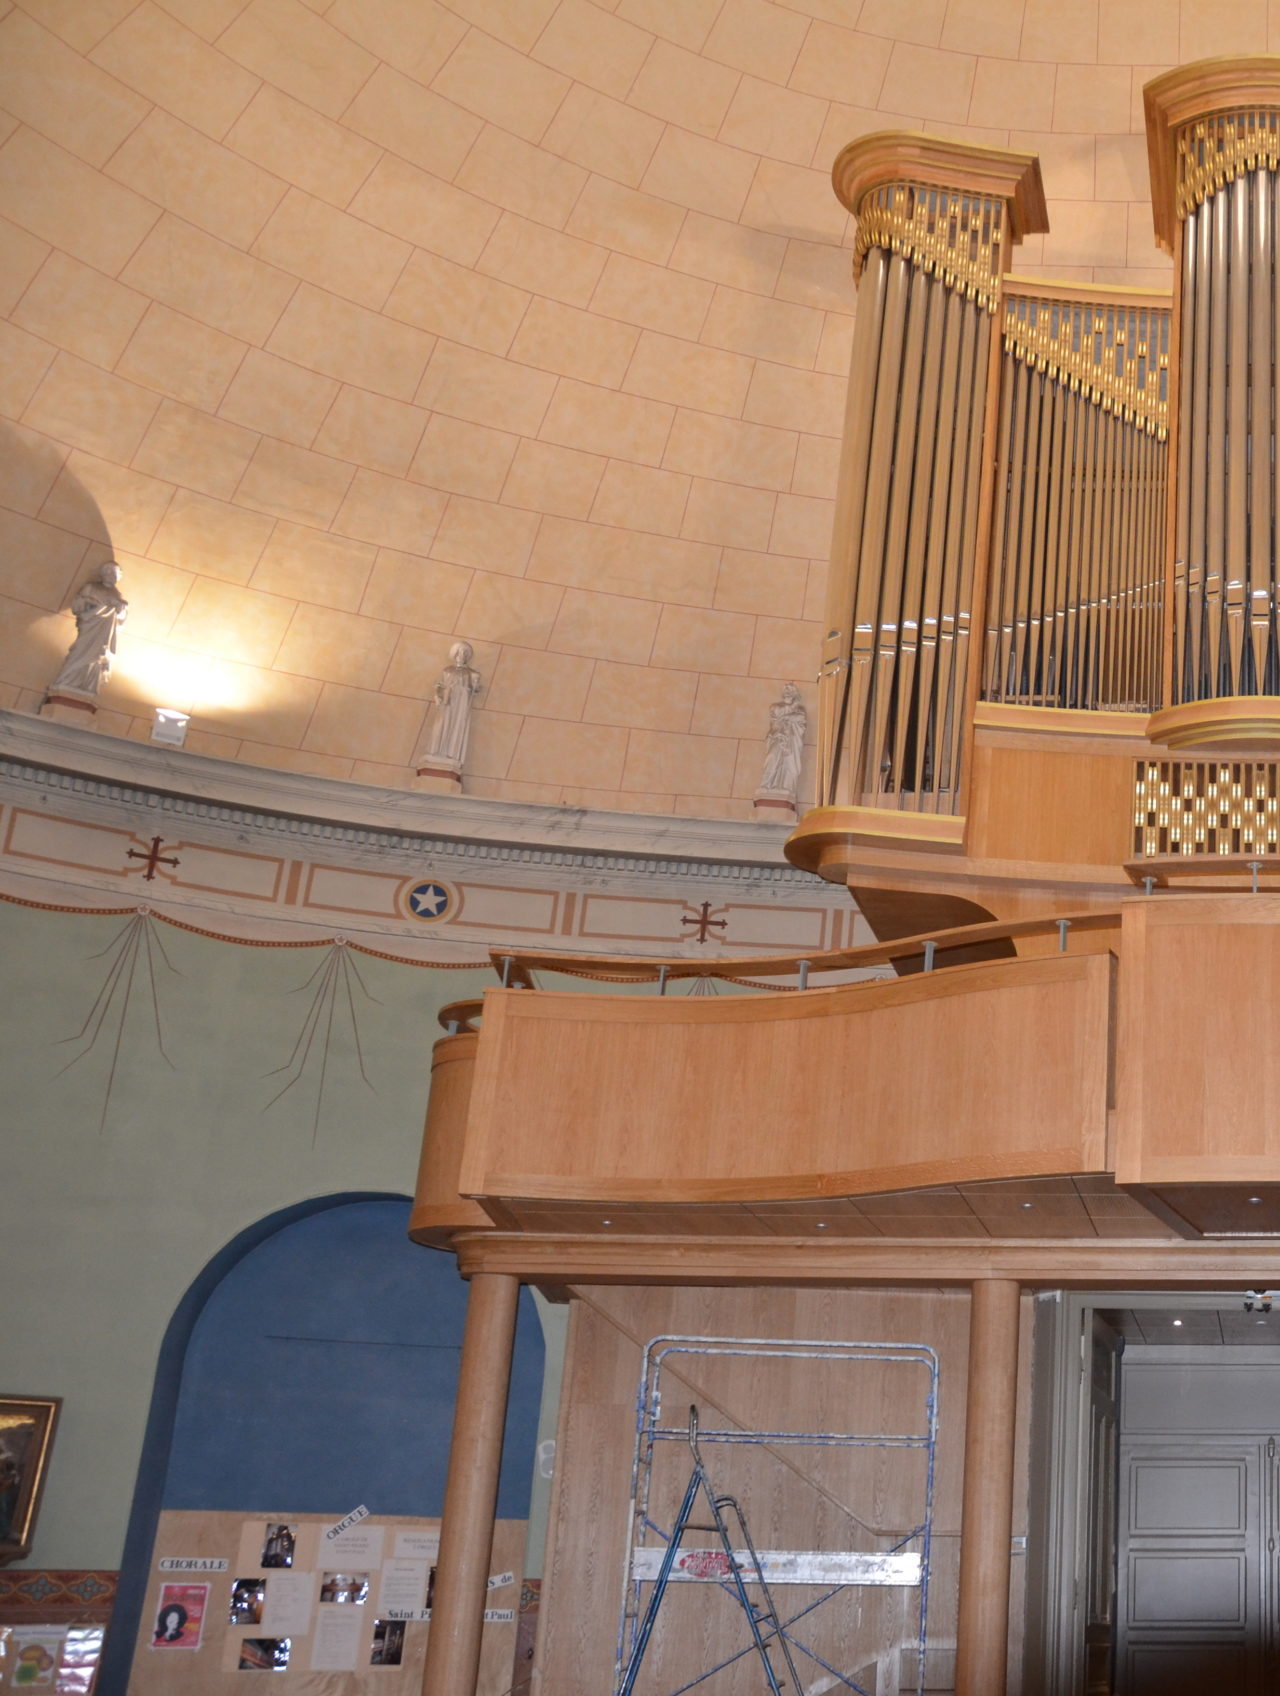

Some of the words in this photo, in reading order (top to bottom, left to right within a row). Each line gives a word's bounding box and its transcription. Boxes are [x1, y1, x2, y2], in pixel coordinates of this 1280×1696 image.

[326, 1506, 368, 1541] ORGUE
[160, 1559, 226, 1570] CHORALE
[388, 1609, 414, 1619] Saint
